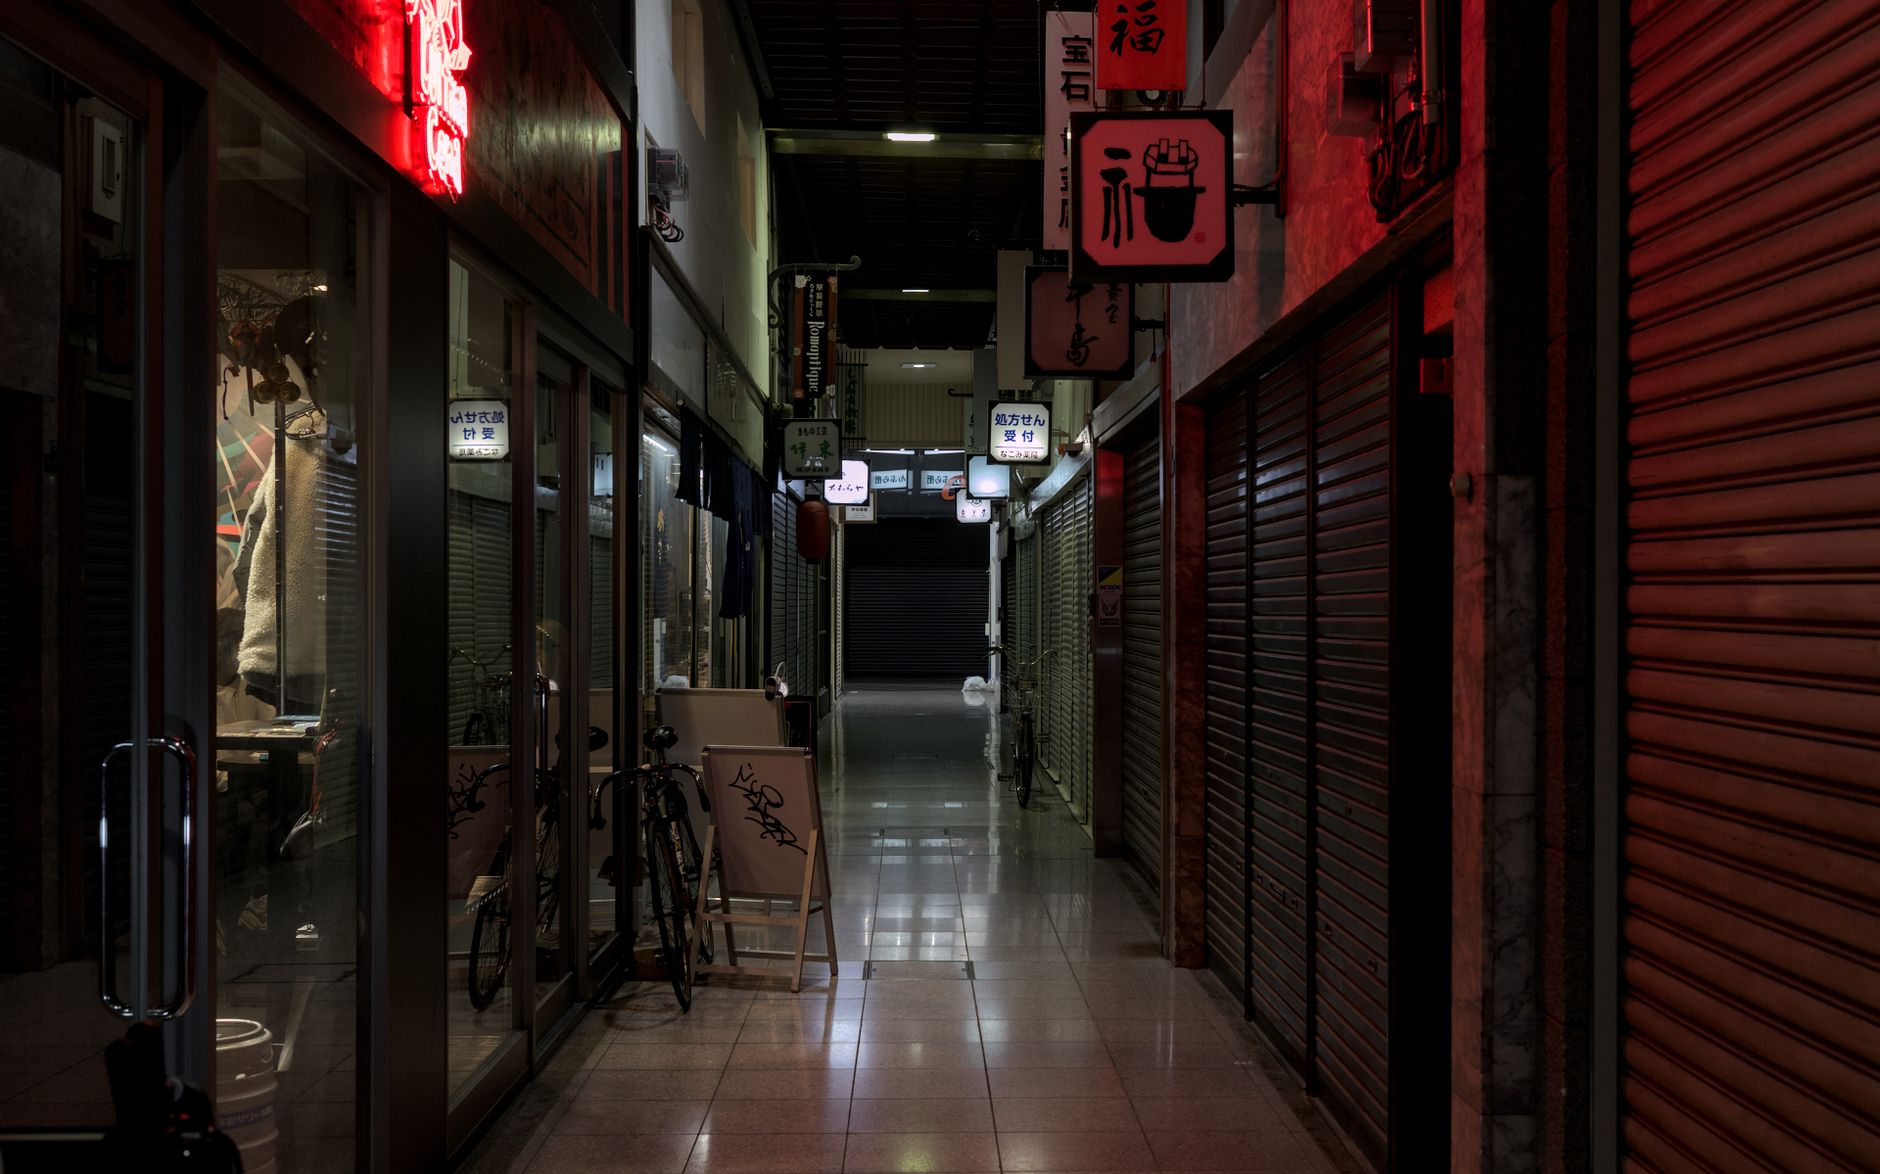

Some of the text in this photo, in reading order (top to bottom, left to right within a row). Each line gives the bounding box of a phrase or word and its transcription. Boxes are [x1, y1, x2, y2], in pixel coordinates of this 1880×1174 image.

[1110, 0, 1165, 57] 福
[1060, 35, 1092, 101] 宝石
[995, 413, 1046, 426] 処方せん
[1004, 430, 1034, 442] 受付
